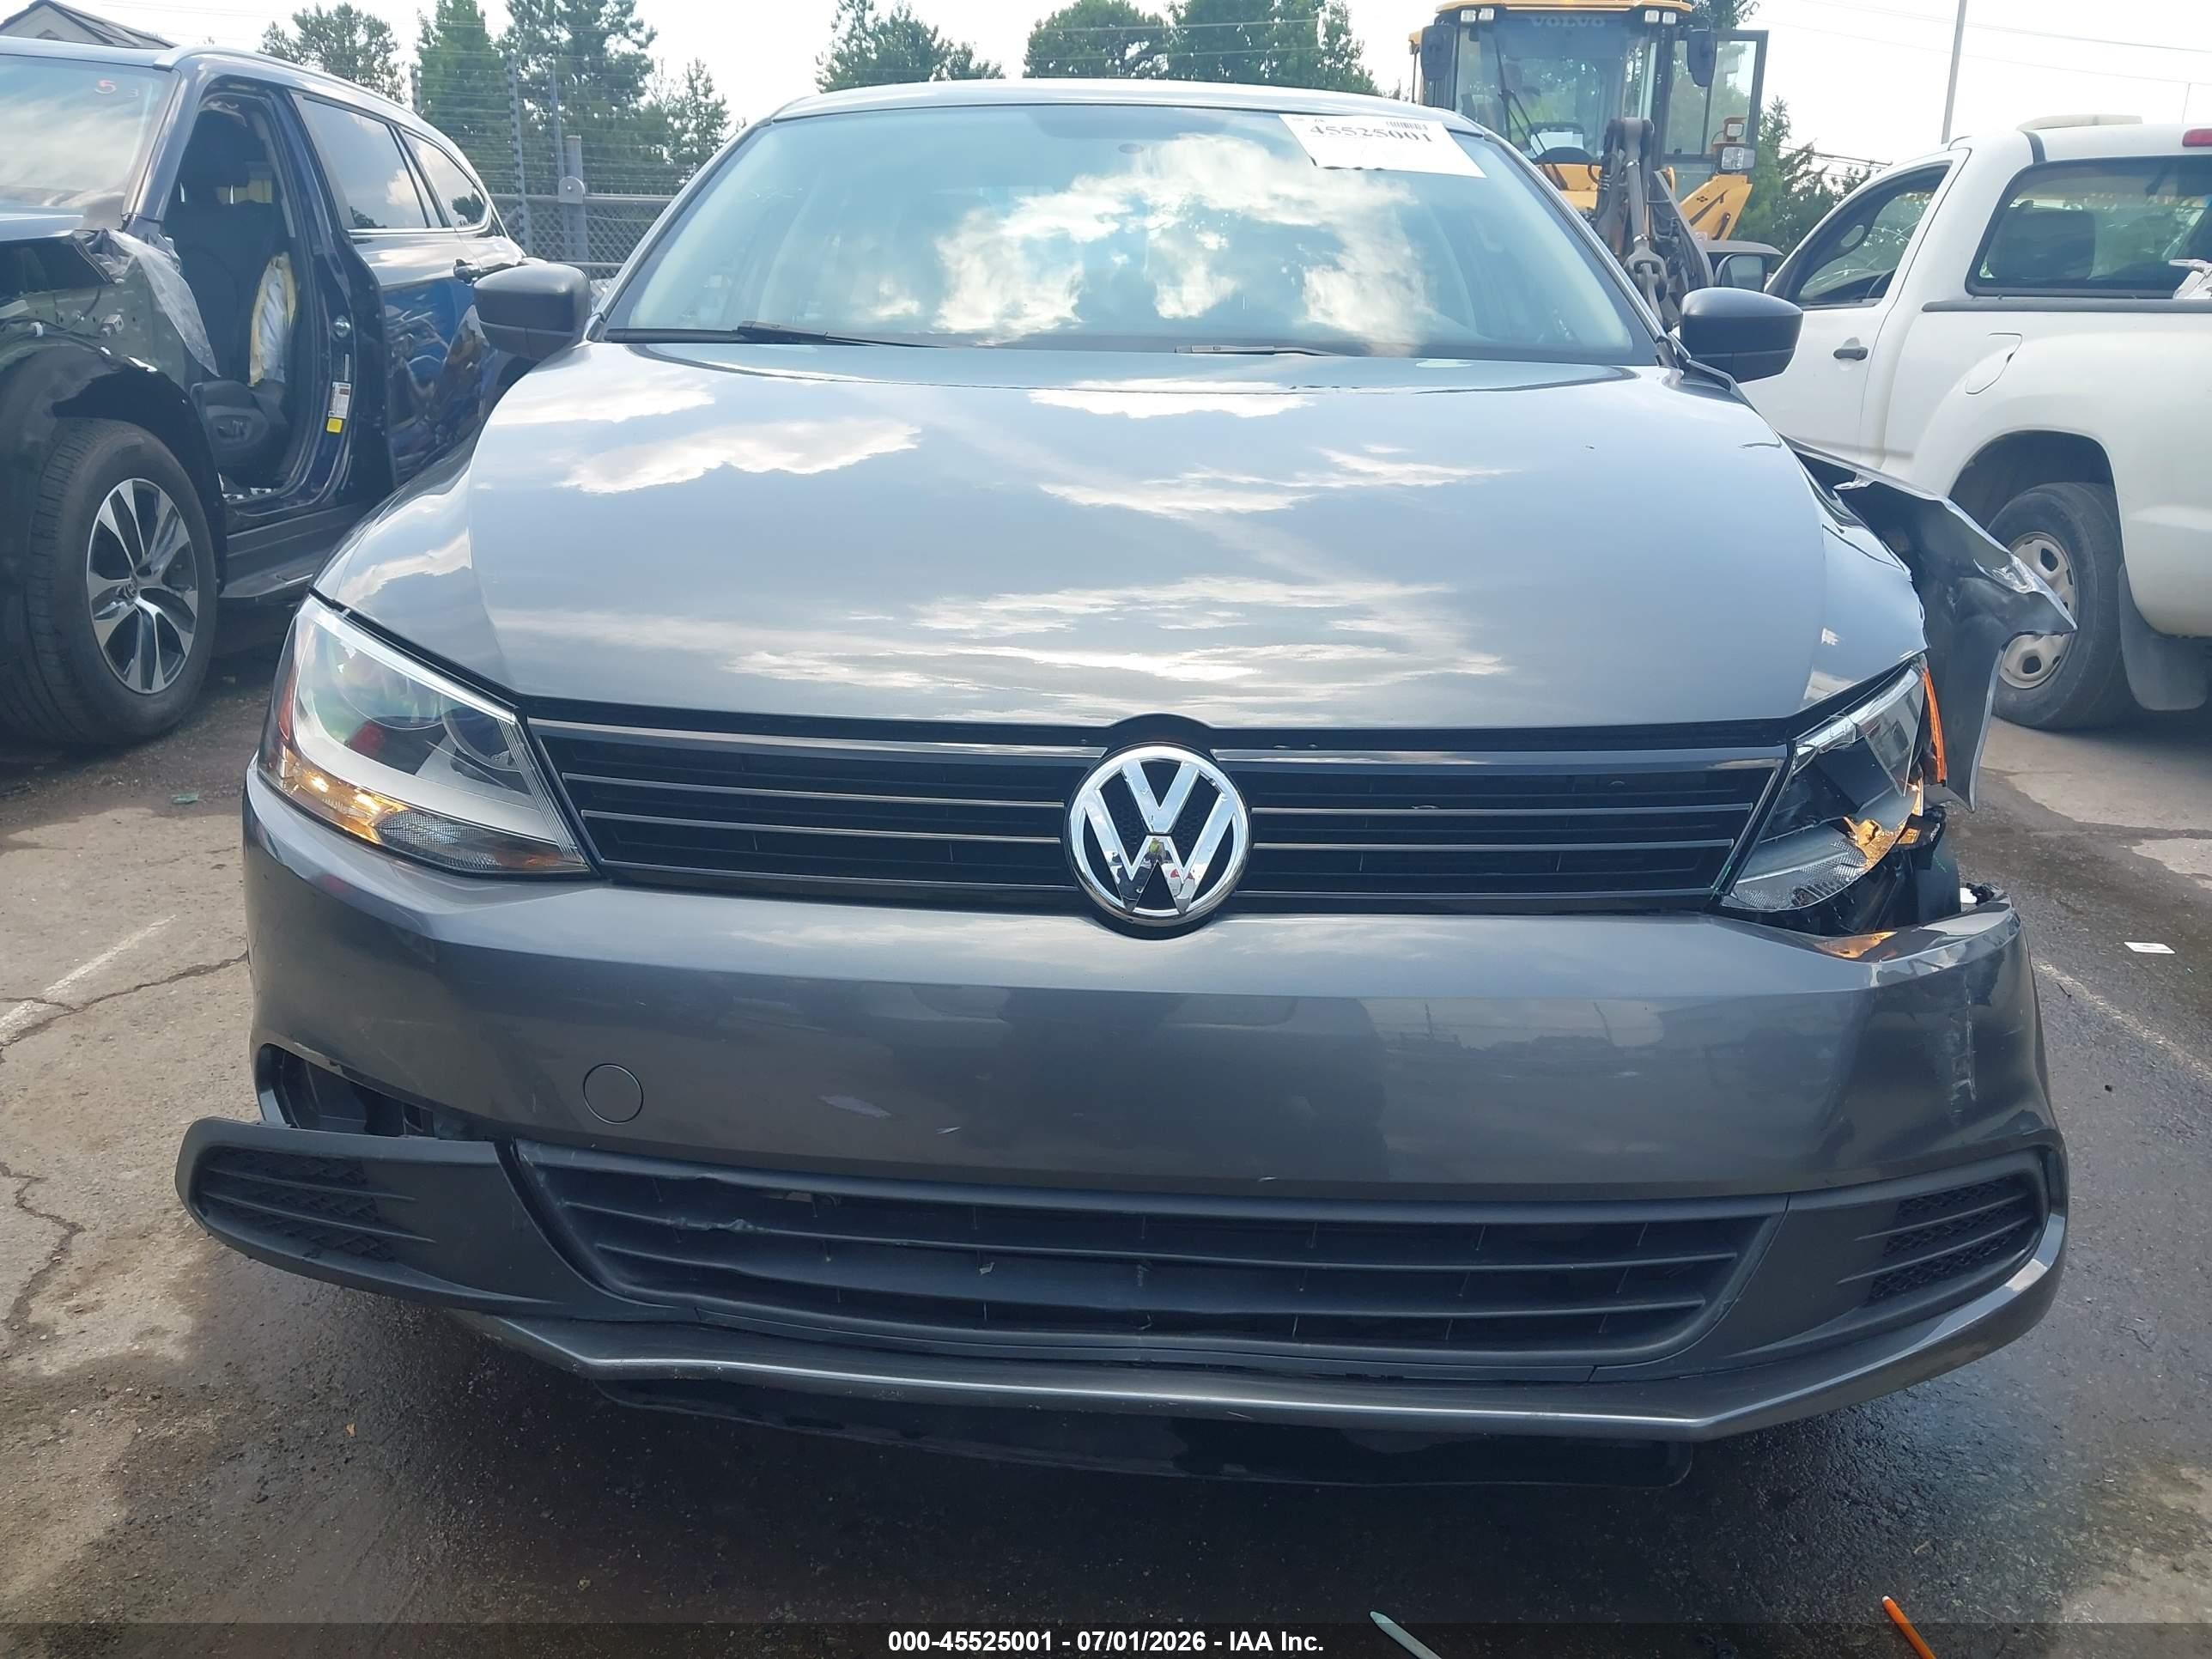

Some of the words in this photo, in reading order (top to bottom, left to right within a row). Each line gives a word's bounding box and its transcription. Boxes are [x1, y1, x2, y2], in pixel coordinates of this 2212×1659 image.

[1528, 15, 1606, 27] VOLVO
[1310, 125, 1432, 143] 45525001
[1077, 754, 1243, 921] VW
